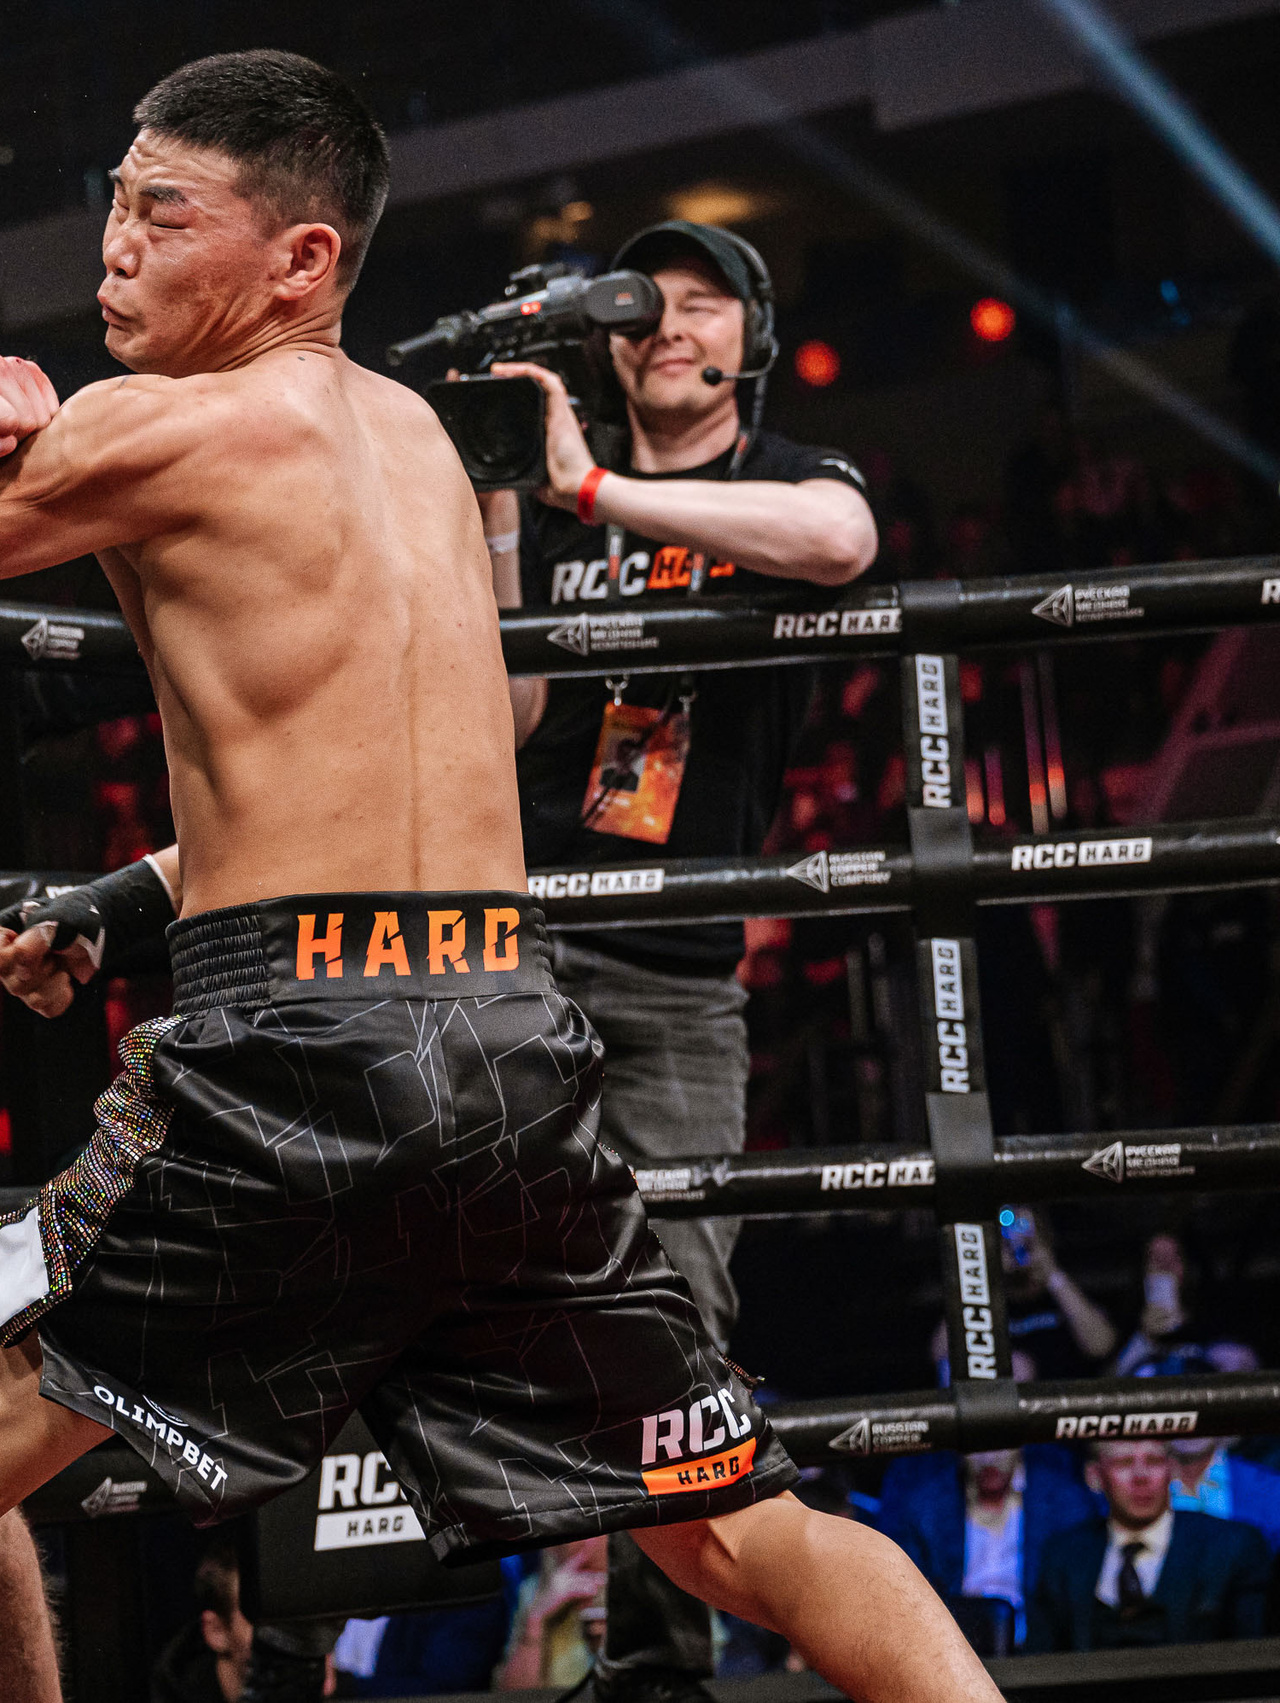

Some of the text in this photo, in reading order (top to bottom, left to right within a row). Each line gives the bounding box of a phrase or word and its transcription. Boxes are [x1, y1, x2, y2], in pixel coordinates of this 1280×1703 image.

[773, 611, 839, 639] RCC
[921, 735, 952, 808] RCC
[1011, 840, 1148, 872] RCC HARD
[296, 907, 521, 981] HARD
[936, 1020, 969, 1094] RCC
[821, 1162, 888, 1191] RCC
[963, 1306, 997, 1380] RCC
[93, 1385, 229, 1490] OLIMPBET
[641, 1388, 752, 1465] RCC
[1055, 1415, 1122, 1440] RCC
[318, 1450, 408, 1511] RC
[676, 1455, 741, 1486] HARD
[346, 1515, 405, 1538] HARD
